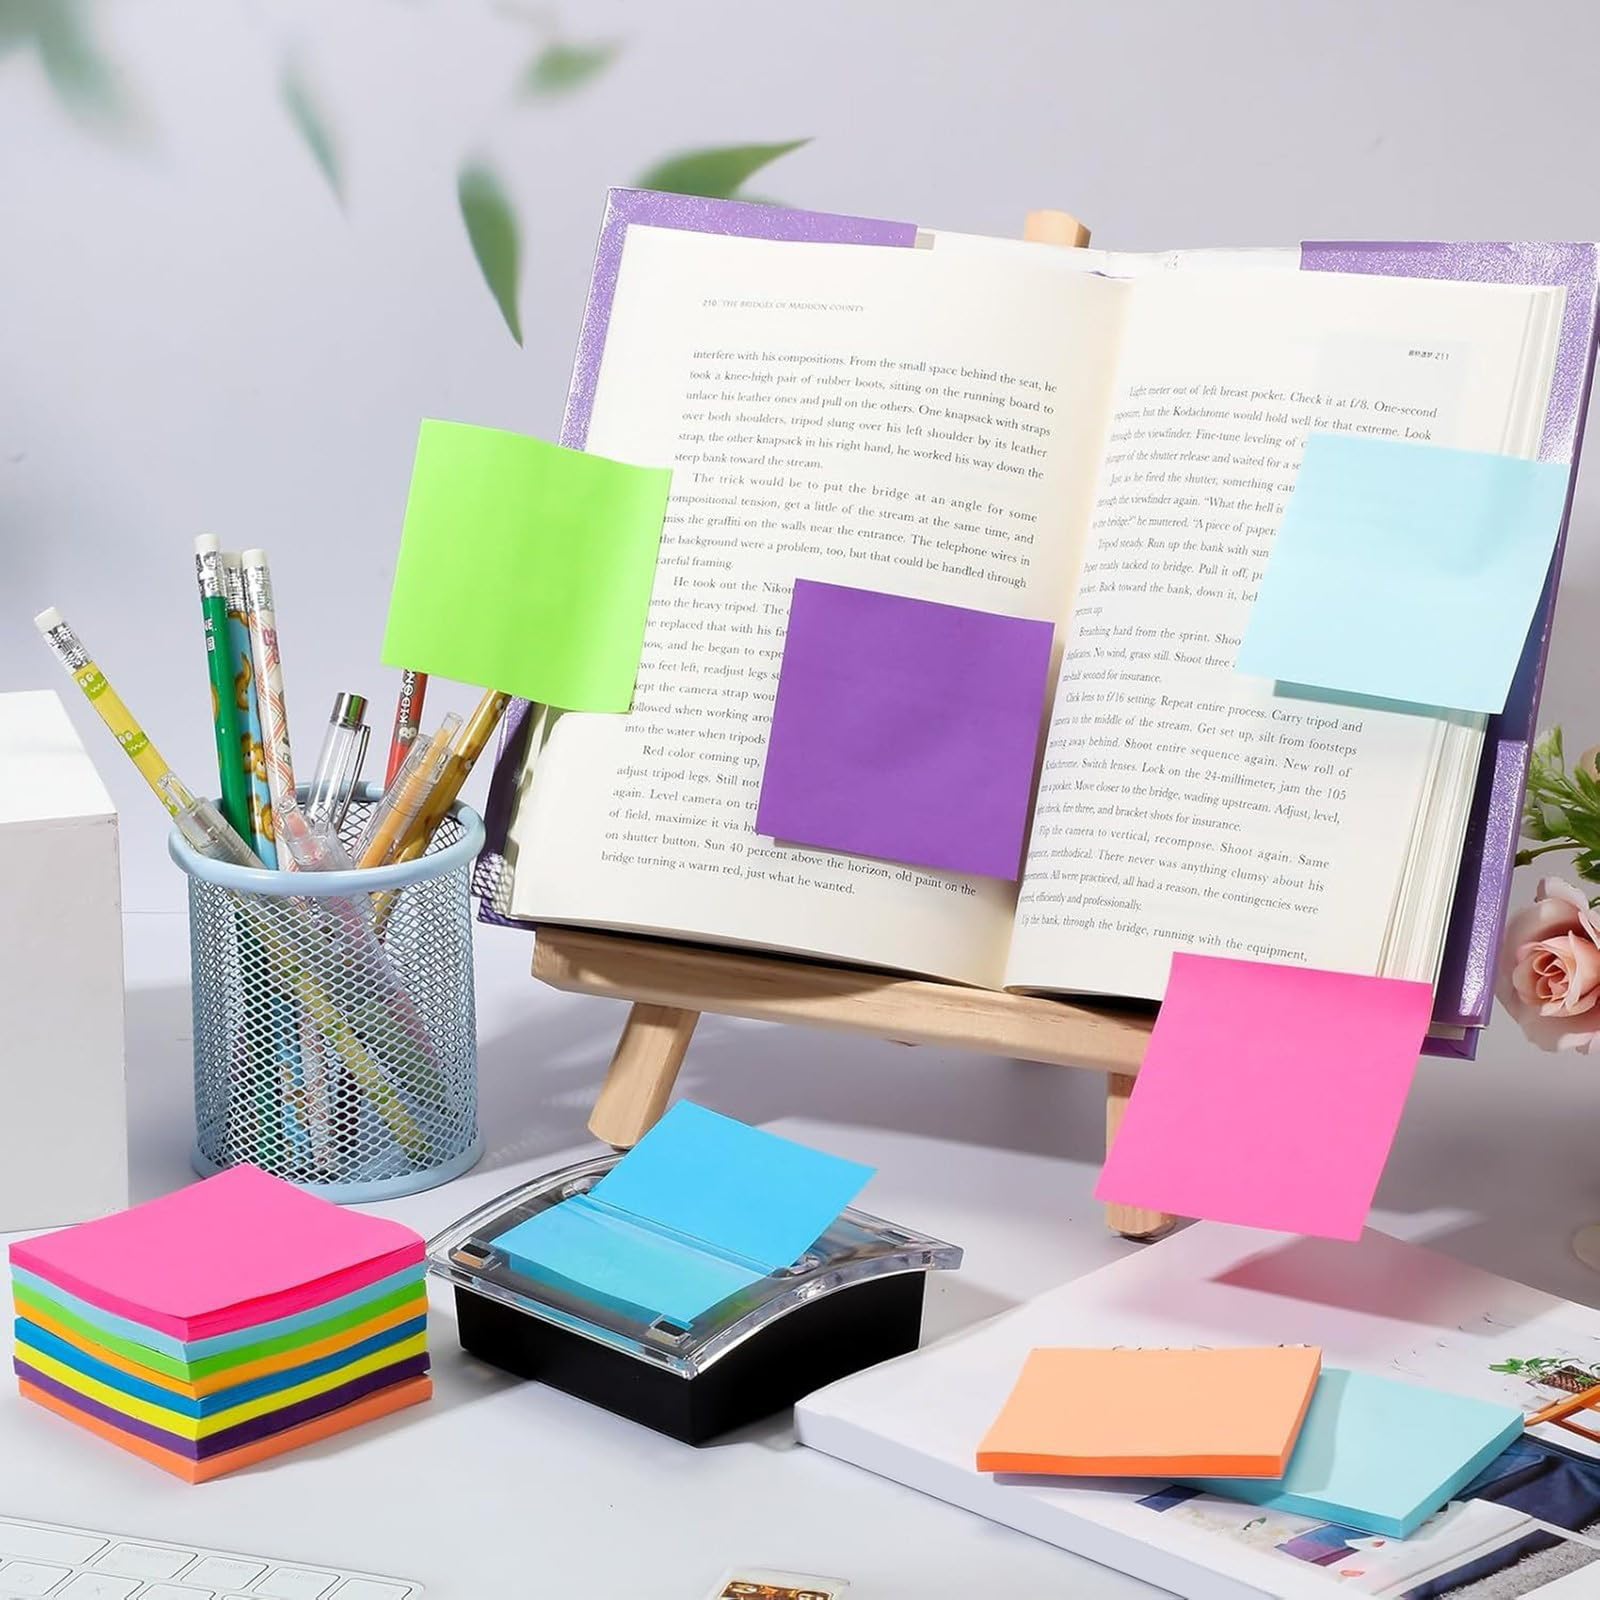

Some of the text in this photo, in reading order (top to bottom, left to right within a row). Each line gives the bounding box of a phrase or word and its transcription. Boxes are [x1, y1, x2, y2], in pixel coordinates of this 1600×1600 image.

[693, 350, 1057, 393] interfere with his compositions. From the small space behind the seat, he
[686, 390, 718, 400] unlace
[721, 391, 735, 400] his
[737, 392, 771, 402] leather
[799, 395, 820, 405] and
[821, 396, 842, 408] pull
[844, 400, 858, 408] on
[861, 398, 877, 409] the
[879, 401, 915, 414] others.
[918, 404, 942, 416] One
[944, 407, 993, 425] knapsack
[995, 417, 1018, 430] with
[1020, 423, 1051, 438] straps
[1142, 407, 1155, 416] but
[1157, 406, 1170, 416] the
[1172, 405, 1230, 419] Kodachrome
[1233, 410, 1263, 421] would
[1265, 411, 1288, 424] hold
[1291, 415, 1312, 426] well
[1313, 416, 1329, 428] for
[1332, 418, 1353, 431] that
[1355, 424, 1400, 436] extreme.
[1404, 426, 1431, 440] Look
[1172, 387, 1187, 395] out
[1189, 384, 1201, 395] of
[1202, 385, 1217, 396] left
[1219, 386, 1248, 398] breast
[1250, 389, 1285, 402] pocket.
[1289, 391, 1322, 404] Check
[1325, 395, 1333, 406] it
[1336, 399, 1346, 408] at
[1349, 398, 1369, 410] f/8.
[1374, 400, 1438, 418] One-second
[678, 432, 1044, 479] strap, the other knapsack in his right hand, he worked his way down the
[692, 472, 1037, 523] The trick would be to put the bridge at an angle for some
[678, 535, 738, 547] background
[740, 541, 765, 549] were
[775, 542, 823, 555] problem,
[826, 547, 846, 558] too,
[849, 547, 867, 559] but
[870, 550, 891, 563] that
[893, 556, 925, 568] could
[924, 558, 939, 571] be
[941, 561, 985, 579] handled
[987, 570, 1027, 589] through
[642, 745, 760, 768] Red color coming up,
[1088, 736, 1353, 778] behind. Shoot entire sequence again. New roll of
[1081, 757, 1107, 769] Switch
[1109, 759, 1137, 771] lenses.
[1141, 761, 1165, 775] Lock
[1167, 768, 1181, 776] on
[1184, 767, 1201, 779] the
[1204, 769, 1276, 792] 24-millimeter,
[1277, 780, 1300, 794] jam
[1304, 785, 1322, 797] the
[1324, 786, 1346, 800] 105
[605, 830, 976, 896] on shutter button. Sun 40 percent above the horizon, old paint on the
[1064, 827, 1329, 868] camera to vertical, recompose. Shoot again. Same
[601, 850, 635, 864] bridge
[637, 855, 677, 870] turning
[688, 862, 719, 872] warm
[722, 865, 743, 877] red,
[744, 870, 765, 880] just
[768, 871, 794, 884] what
[797, 874, 811, 887] he
[814, 880, 855, 894] wanted.
[1062, 914, 1307, 962] through the bridge, running with the equipment,
